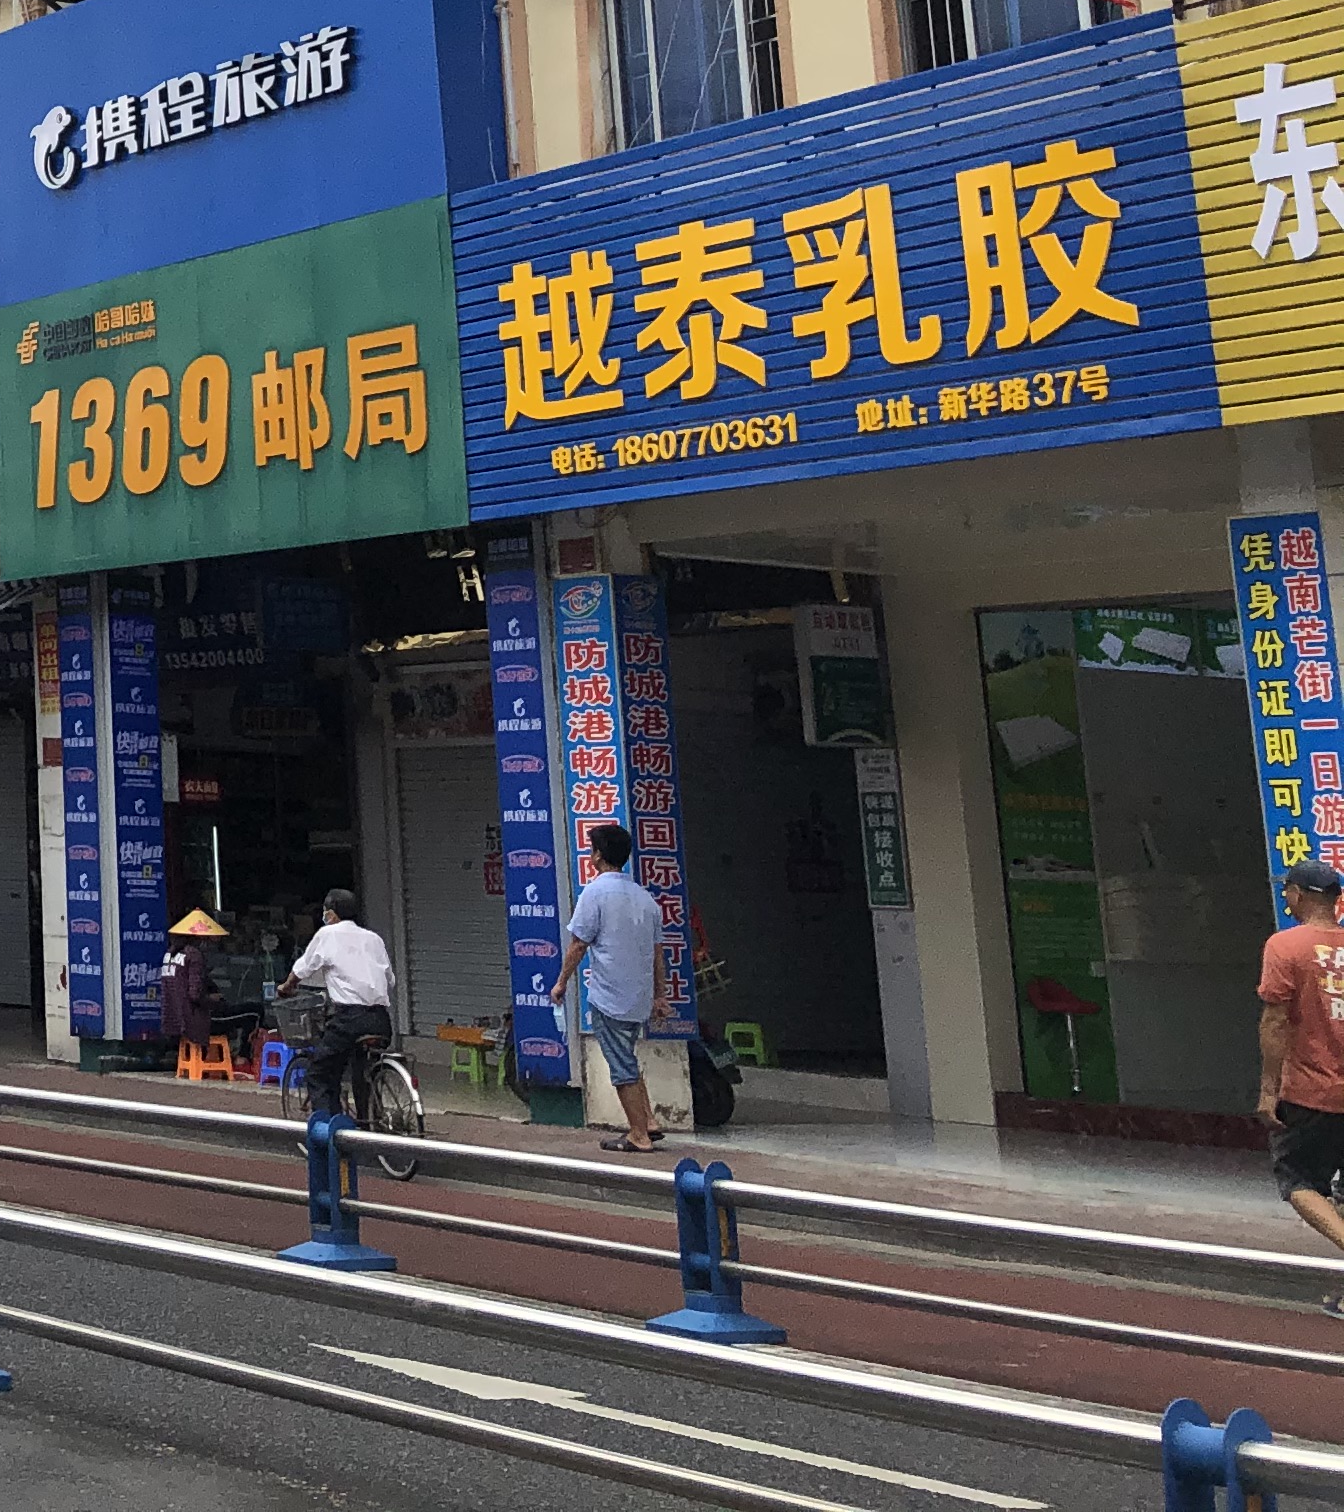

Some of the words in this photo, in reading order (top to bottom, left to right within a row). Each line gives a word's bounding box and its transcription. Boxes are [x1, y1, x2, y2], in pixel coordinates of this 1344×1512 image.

[78, 24, 353, 170] 携程旅游
[1234, 62, 1344, 261] 东
[498, 139, 1140, 431] 越泰乳胶
[29, 355, 231, 509] 1369
[251, 324, 428, 472] 邮局
